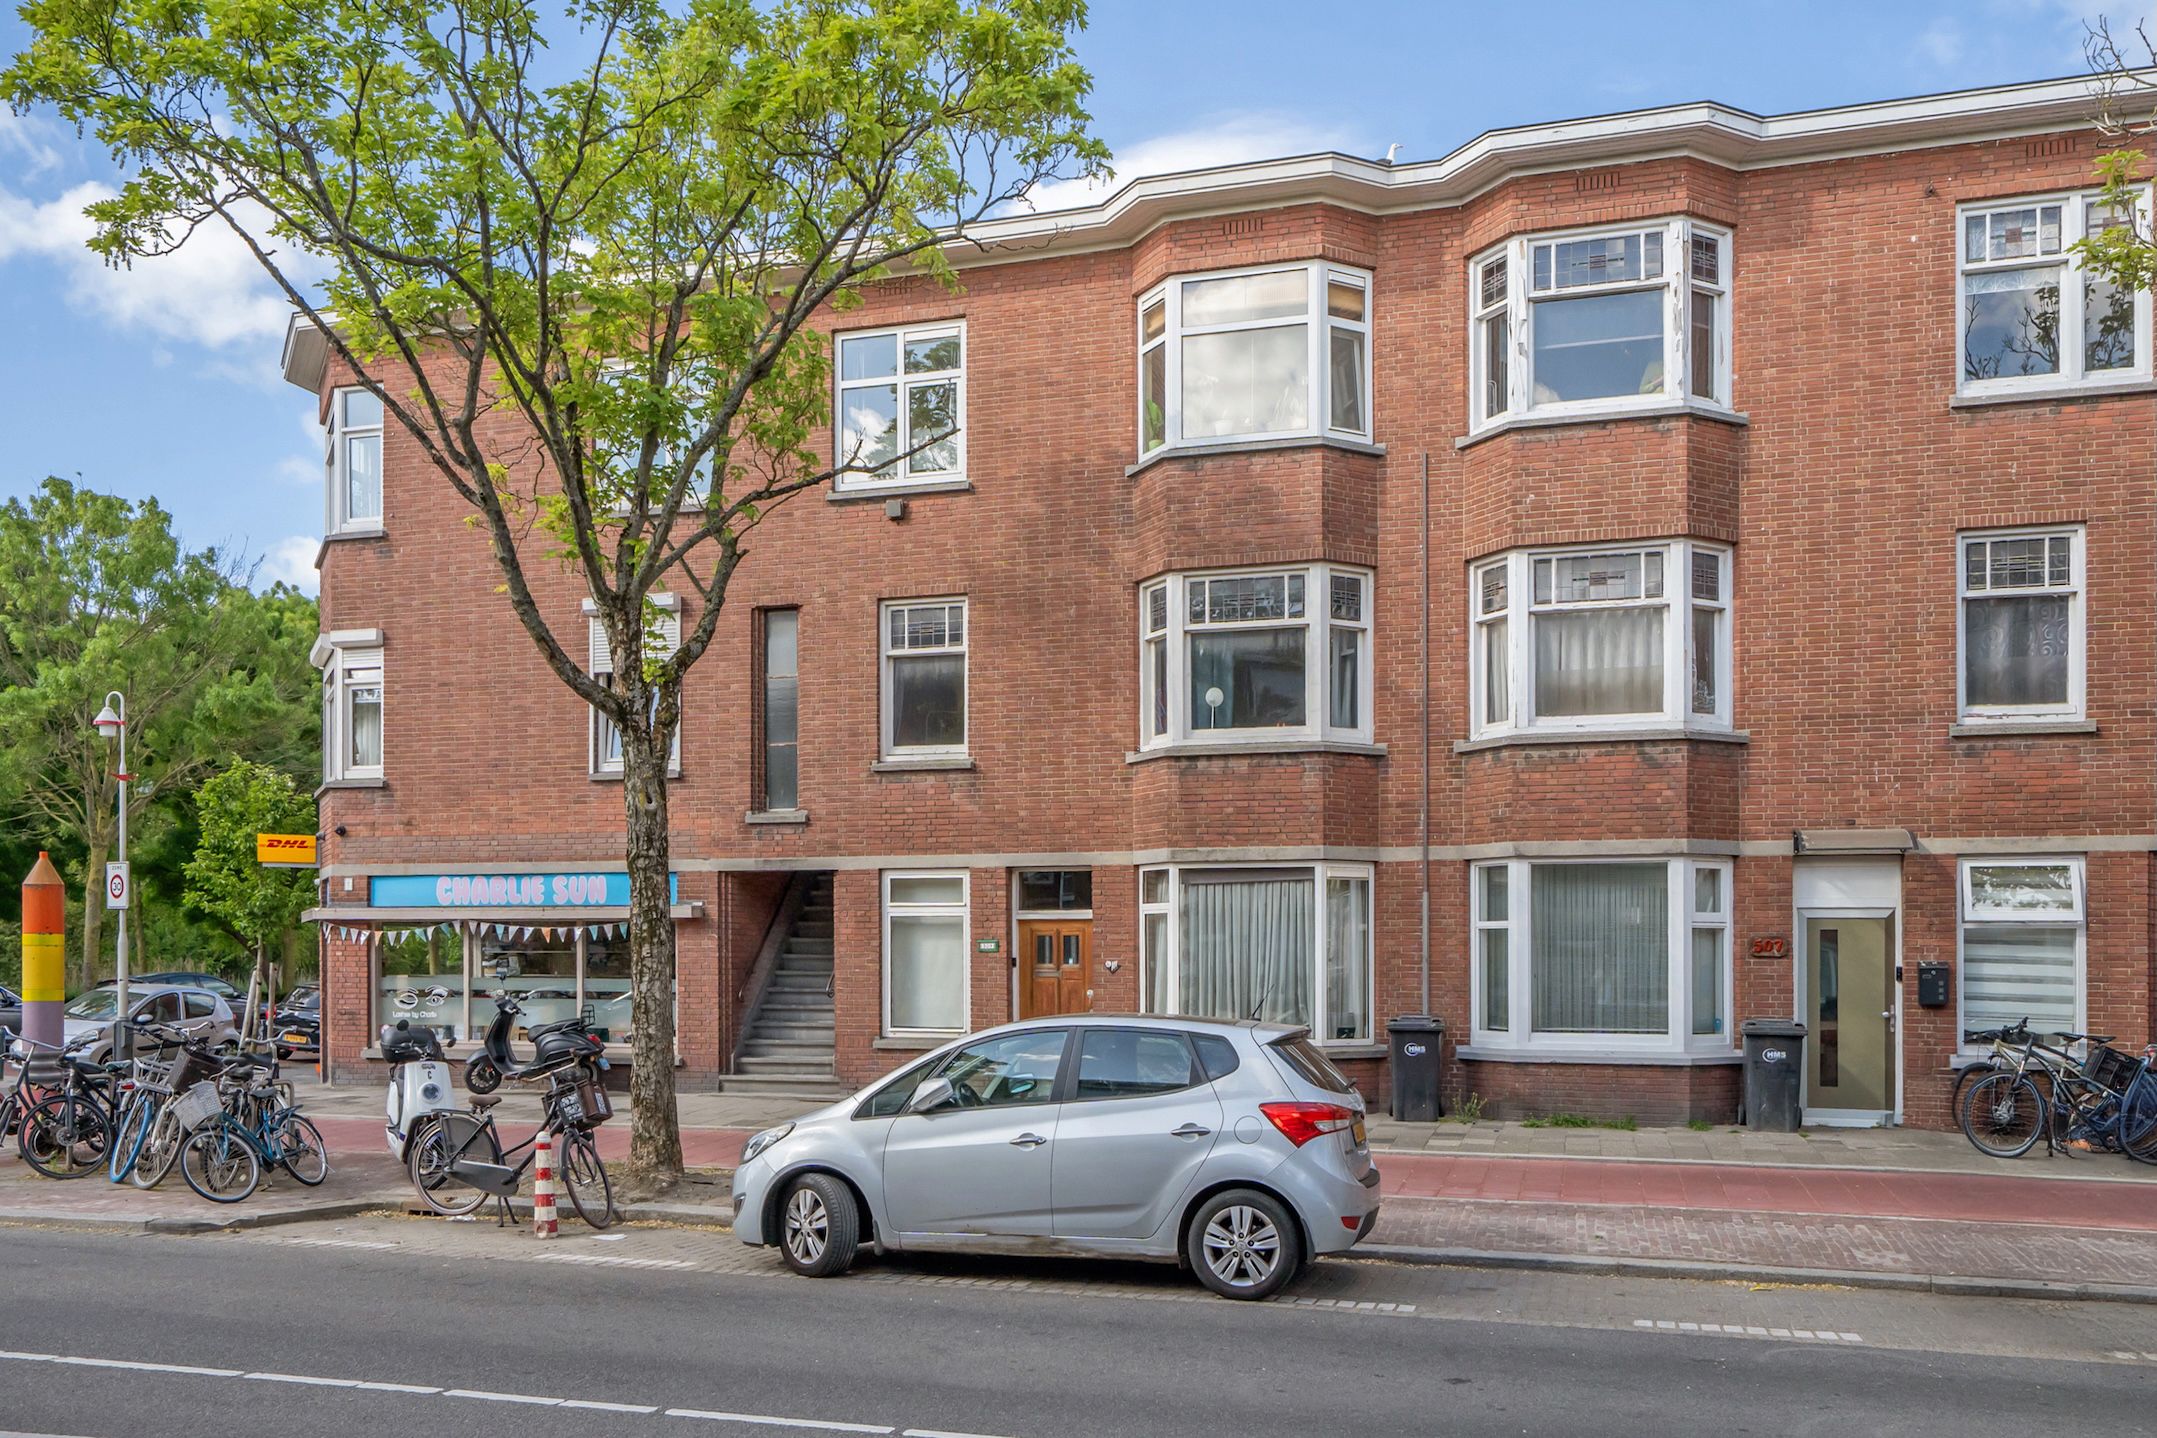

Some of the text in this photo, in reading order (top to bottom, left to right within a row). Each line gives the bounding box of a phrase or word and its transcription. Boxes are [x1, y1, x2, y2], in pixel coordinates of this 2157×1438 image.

[267, 840, 308, 849] DHL
[113, 882, 121, 891] 30
[436, 875, 607, 905] CHARLIE SUN
[1753, 940, 1783, 954] 507
[1408, 1045, 1426, 1054] HMS
[1766, 1051, 1786, 1059] HMS
